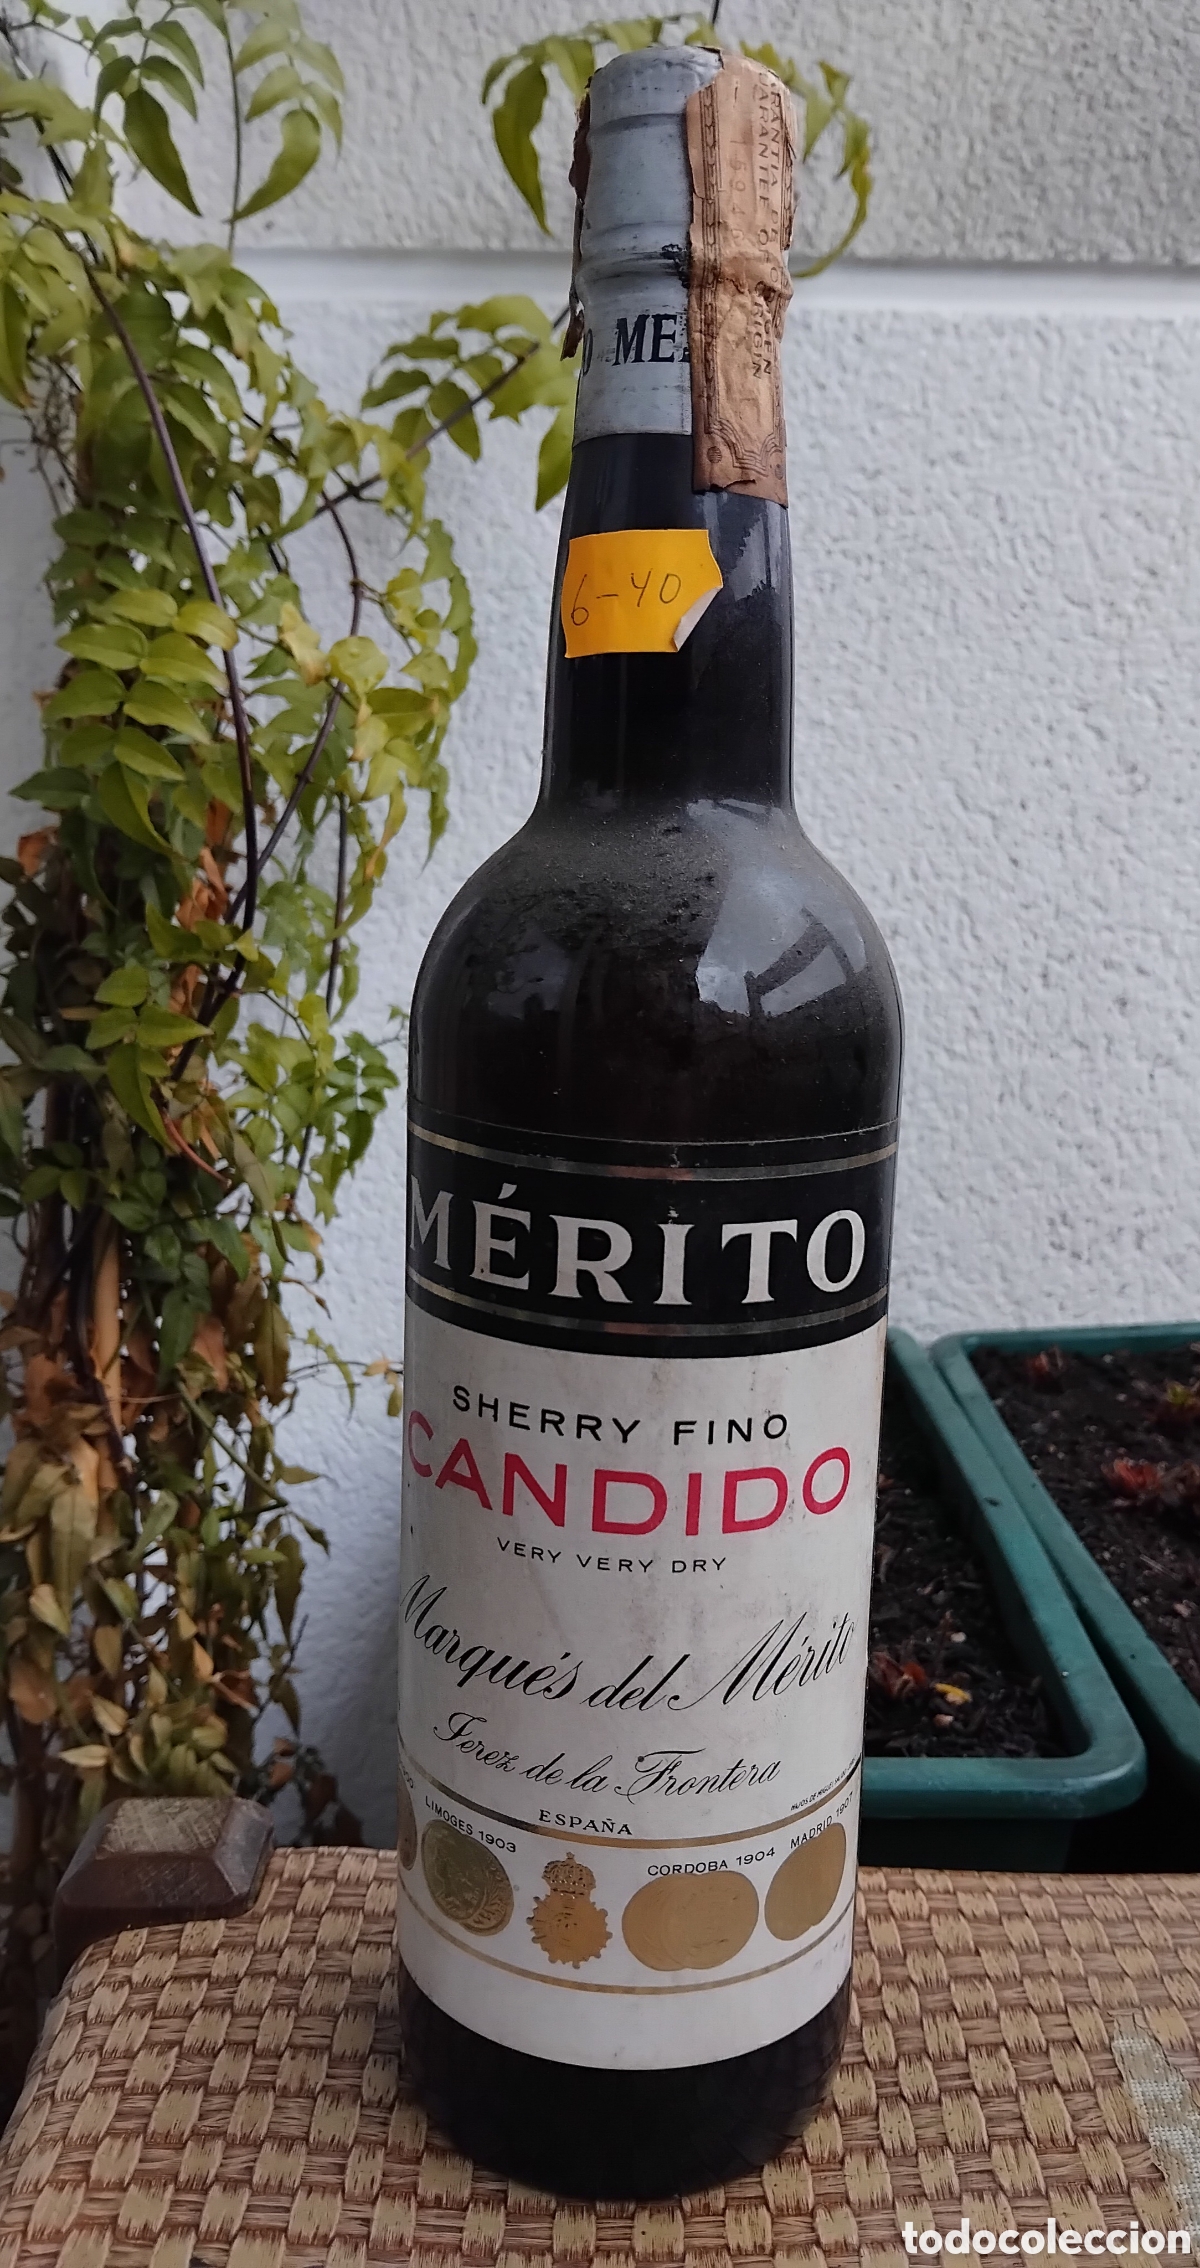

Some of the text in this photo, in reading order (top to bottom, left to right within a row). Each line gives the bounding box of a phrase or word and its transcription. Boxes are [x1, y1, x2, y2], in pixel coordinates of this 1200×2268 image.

[612, 312, 690, 366] ME
[409, 1174, 866, 1306] MÉRITO
[452, 1385, 788, 1446] SHERRY FINO
[408, 1410, 851, 1536] CANDIDO
[497, 1537, 727, 1574] VERY VERY DRY
[400, 1574, 856, 1711] Marqués del Mérito
[519, 1752, 566, 1786] de
[564, 1754, 614, 1793] la
[613, 1747, 782, 1805] Frontera
[424, 1795, 517, 1854] LIMOGES 1903
[538, 1808, 633, 1836] ESPAÑA
[790, 1814, 833, 1850] MADRID
[646, 1846, 776, 1877] CORDOBA 1904
